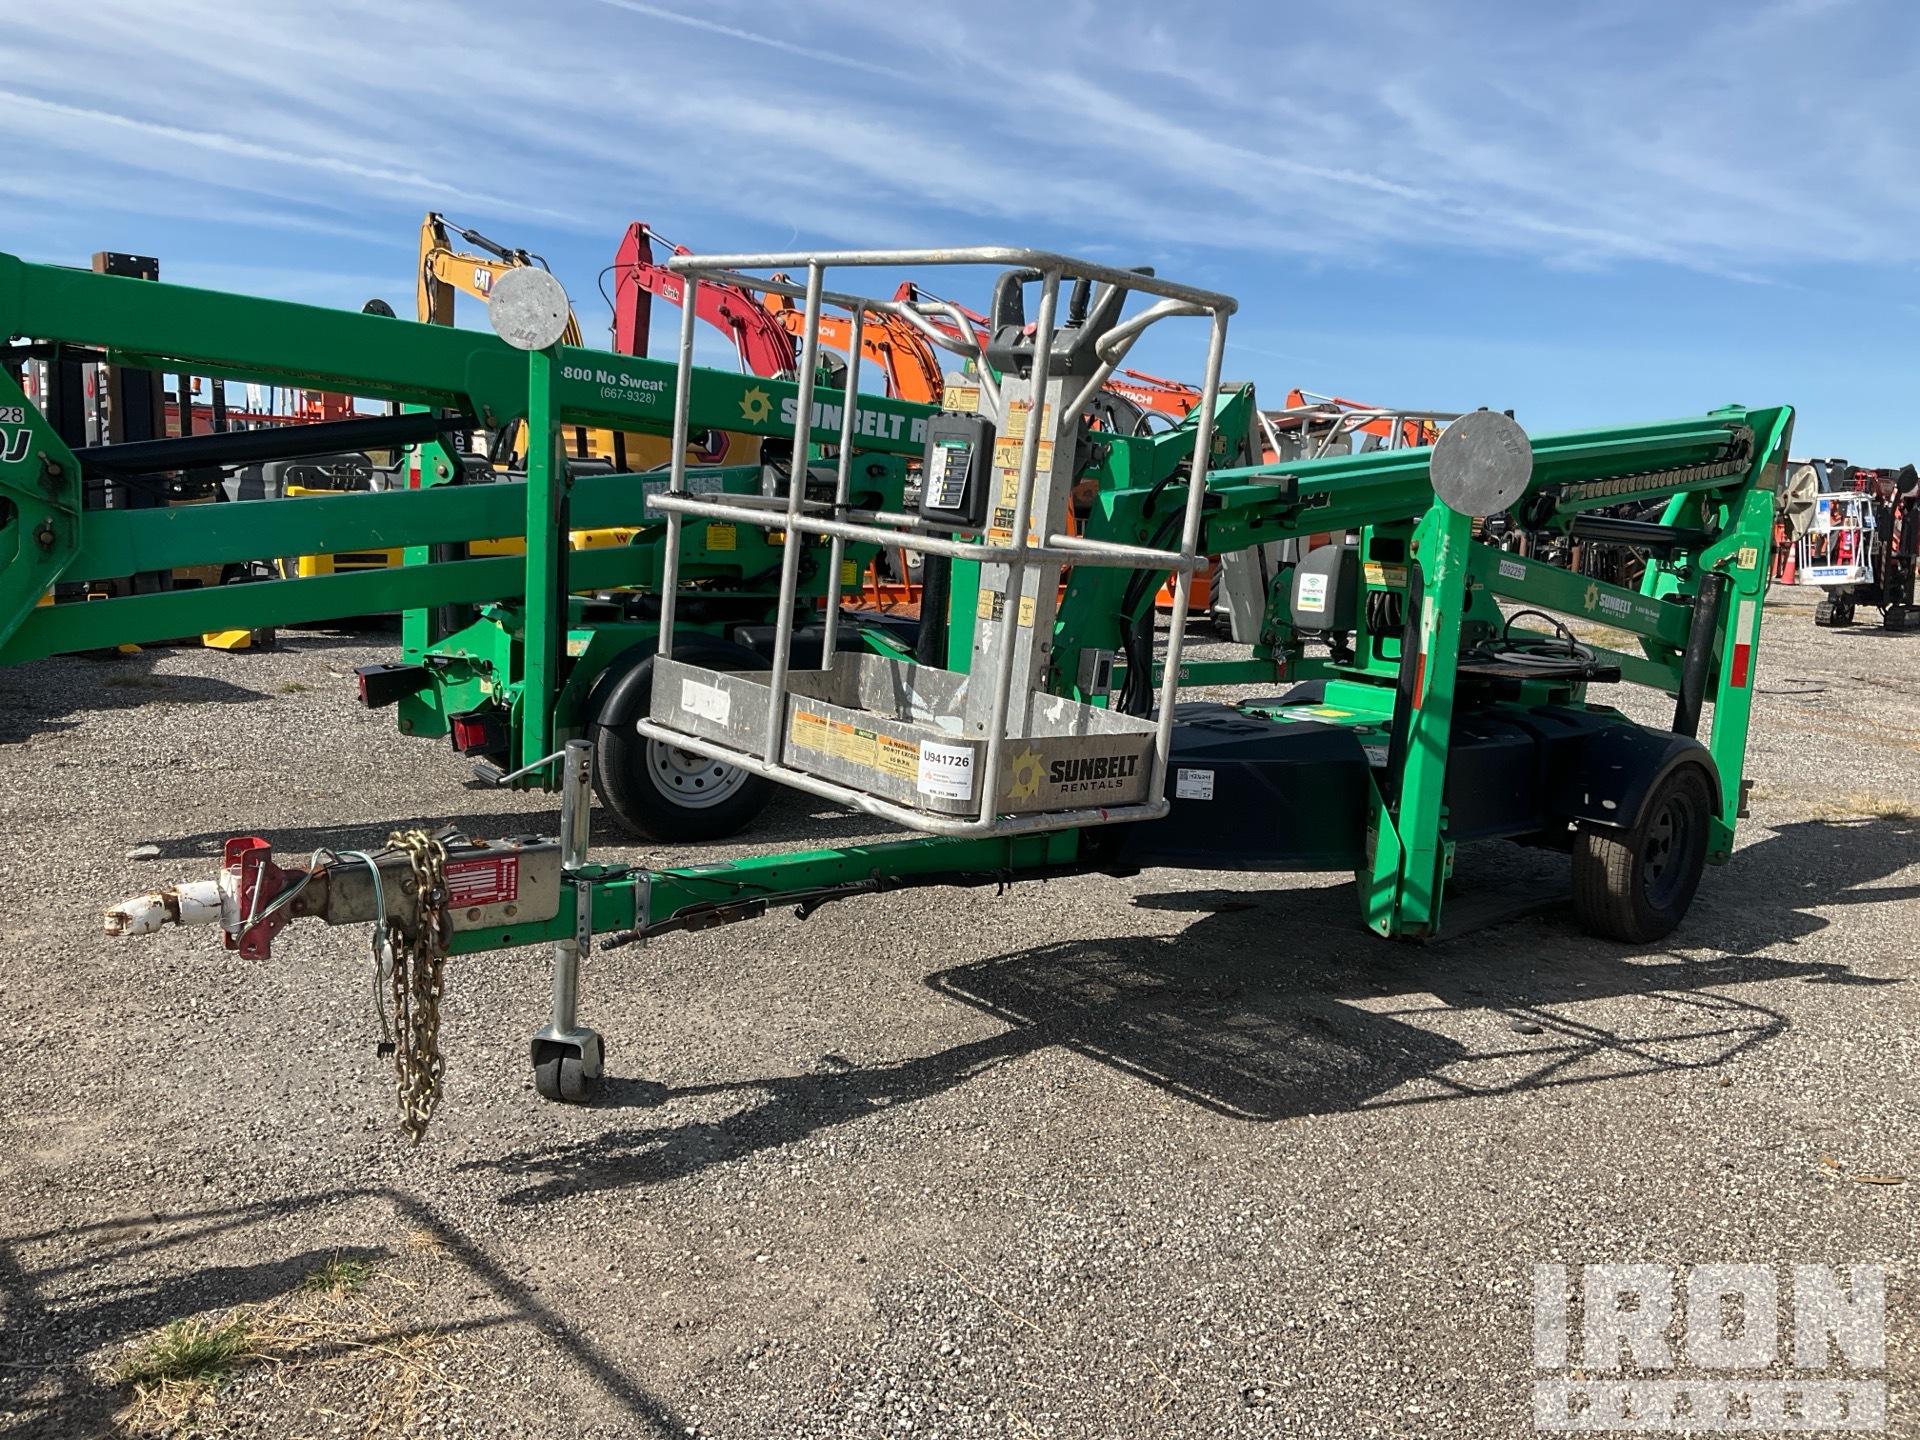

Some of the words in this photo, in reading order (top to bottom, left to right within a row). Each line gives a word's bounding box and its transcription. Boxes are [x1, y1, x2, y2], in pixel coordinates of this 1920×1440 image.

[474, 268, 491, 291] CAT
[596, 370, 616, 385] No
[620, 373, 664, 392] Sweat
[600, 386, 656, 405] (667-9328)
[1500, 563, 1525, 579] 1092257
[1599, 593, 1632, 614] SUNBELT
[924, 750, 970, 768] U941726
[1050, 755, 1139, 784] SUNBELT
[1061, 779, 1123, 793] RENTALS
